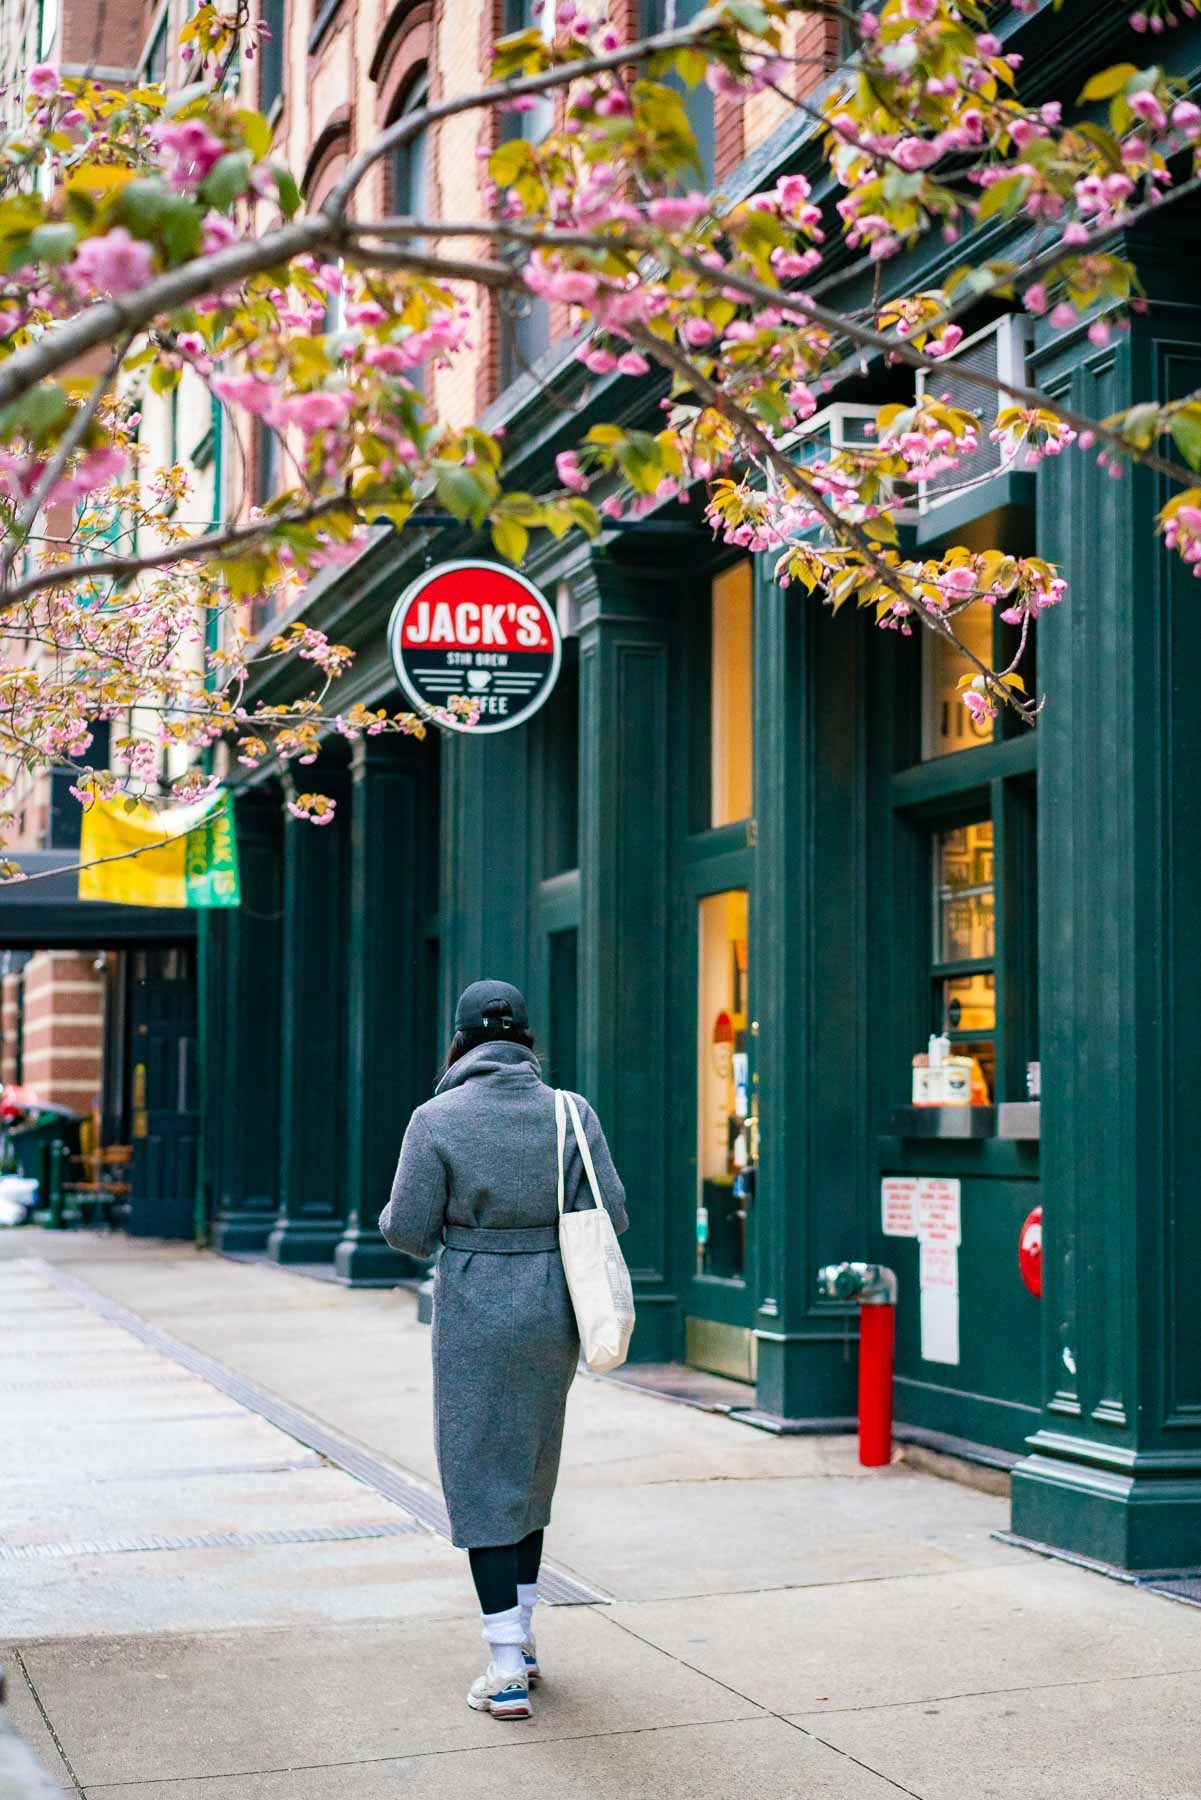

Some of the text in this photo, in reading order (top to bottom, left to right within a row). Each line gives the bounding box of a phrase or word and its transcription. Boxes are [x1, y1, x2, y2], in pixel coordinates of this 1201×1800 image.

[446, 651, 508, 667] STIR BREW
[447, 694, 508, 715] FEE
